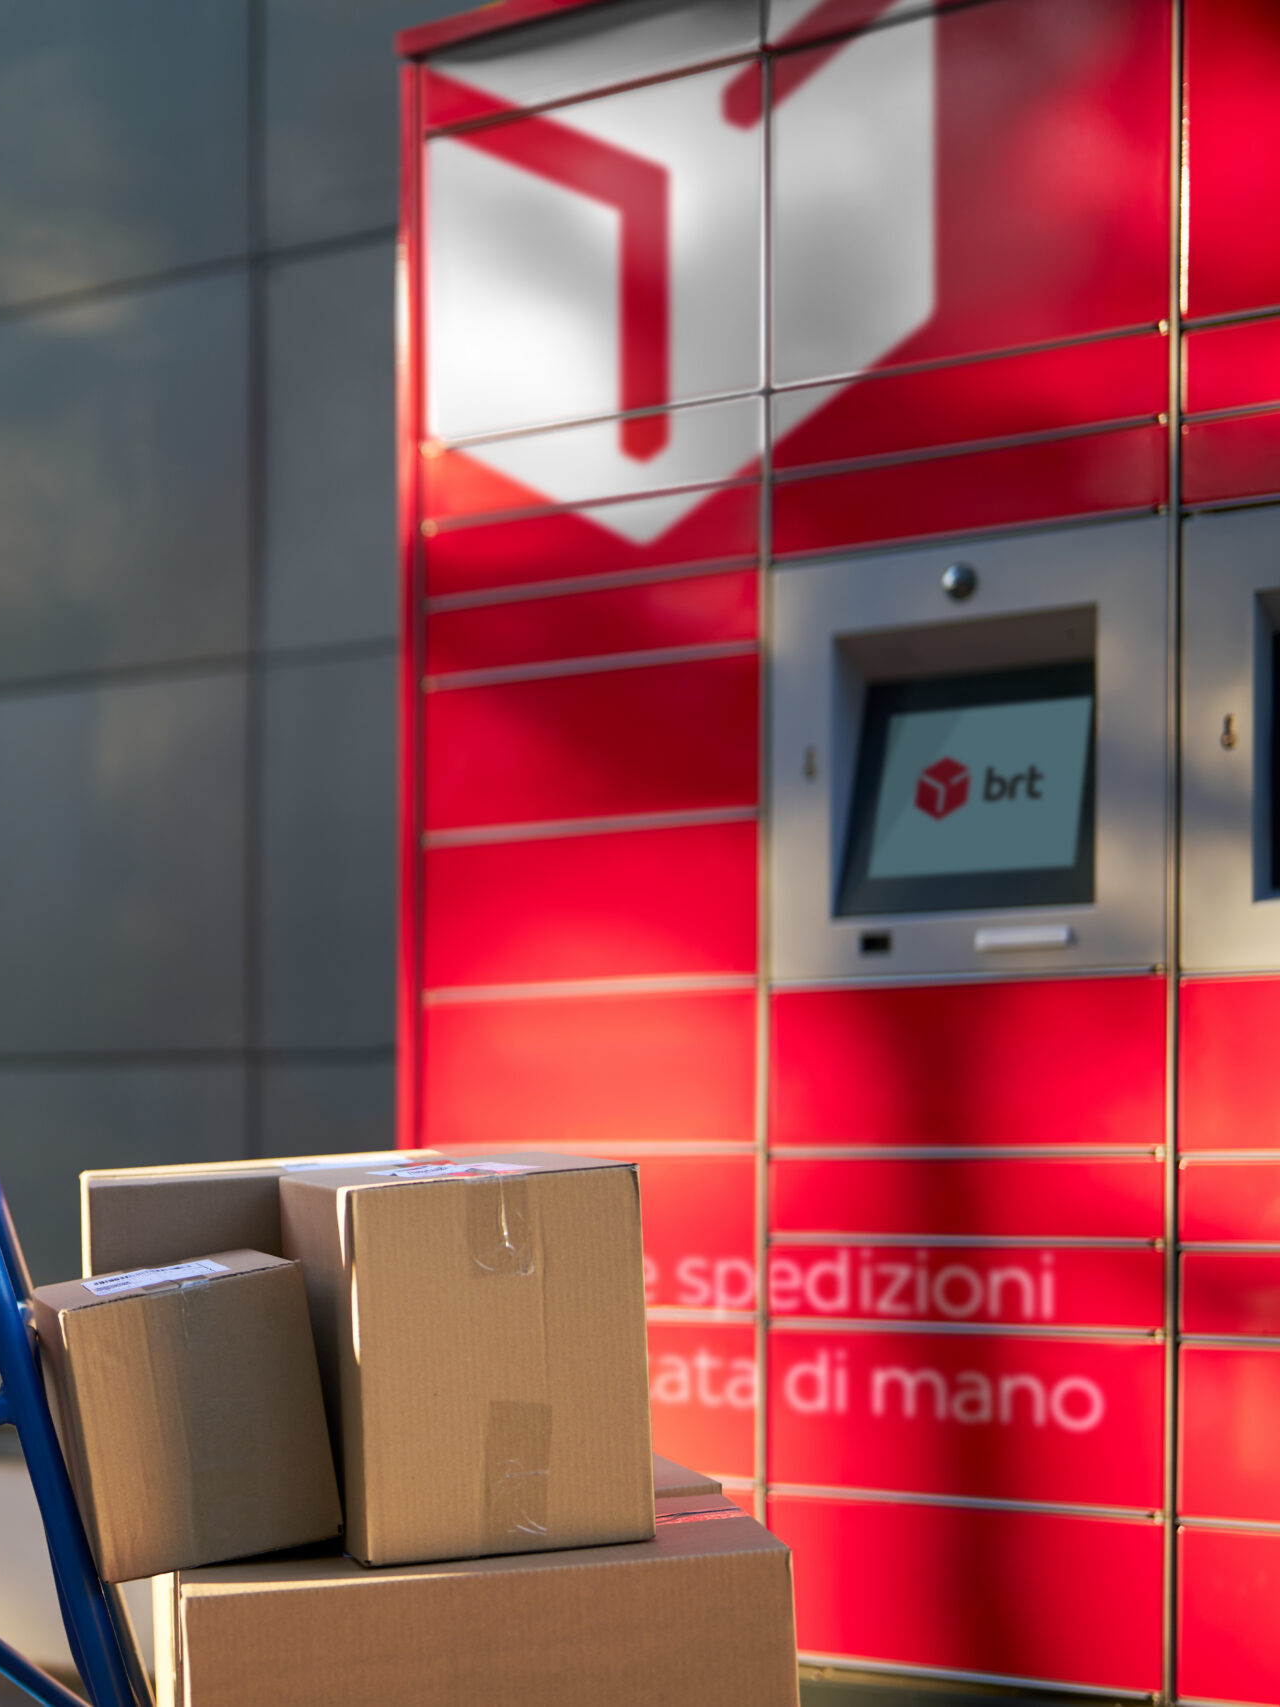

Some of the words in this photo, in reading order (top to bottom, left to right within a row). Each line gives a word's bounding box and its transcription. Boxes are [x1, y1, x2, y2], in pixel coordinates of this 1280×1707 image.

[982, 764, 1044, 802] brt
[675, 1248, 1056, 1322] spedizioni
[647, 1347, 761, 1409] ata
[783, 1349, 848, 1414] di
[870, 1363, 1106, 1433] mano
